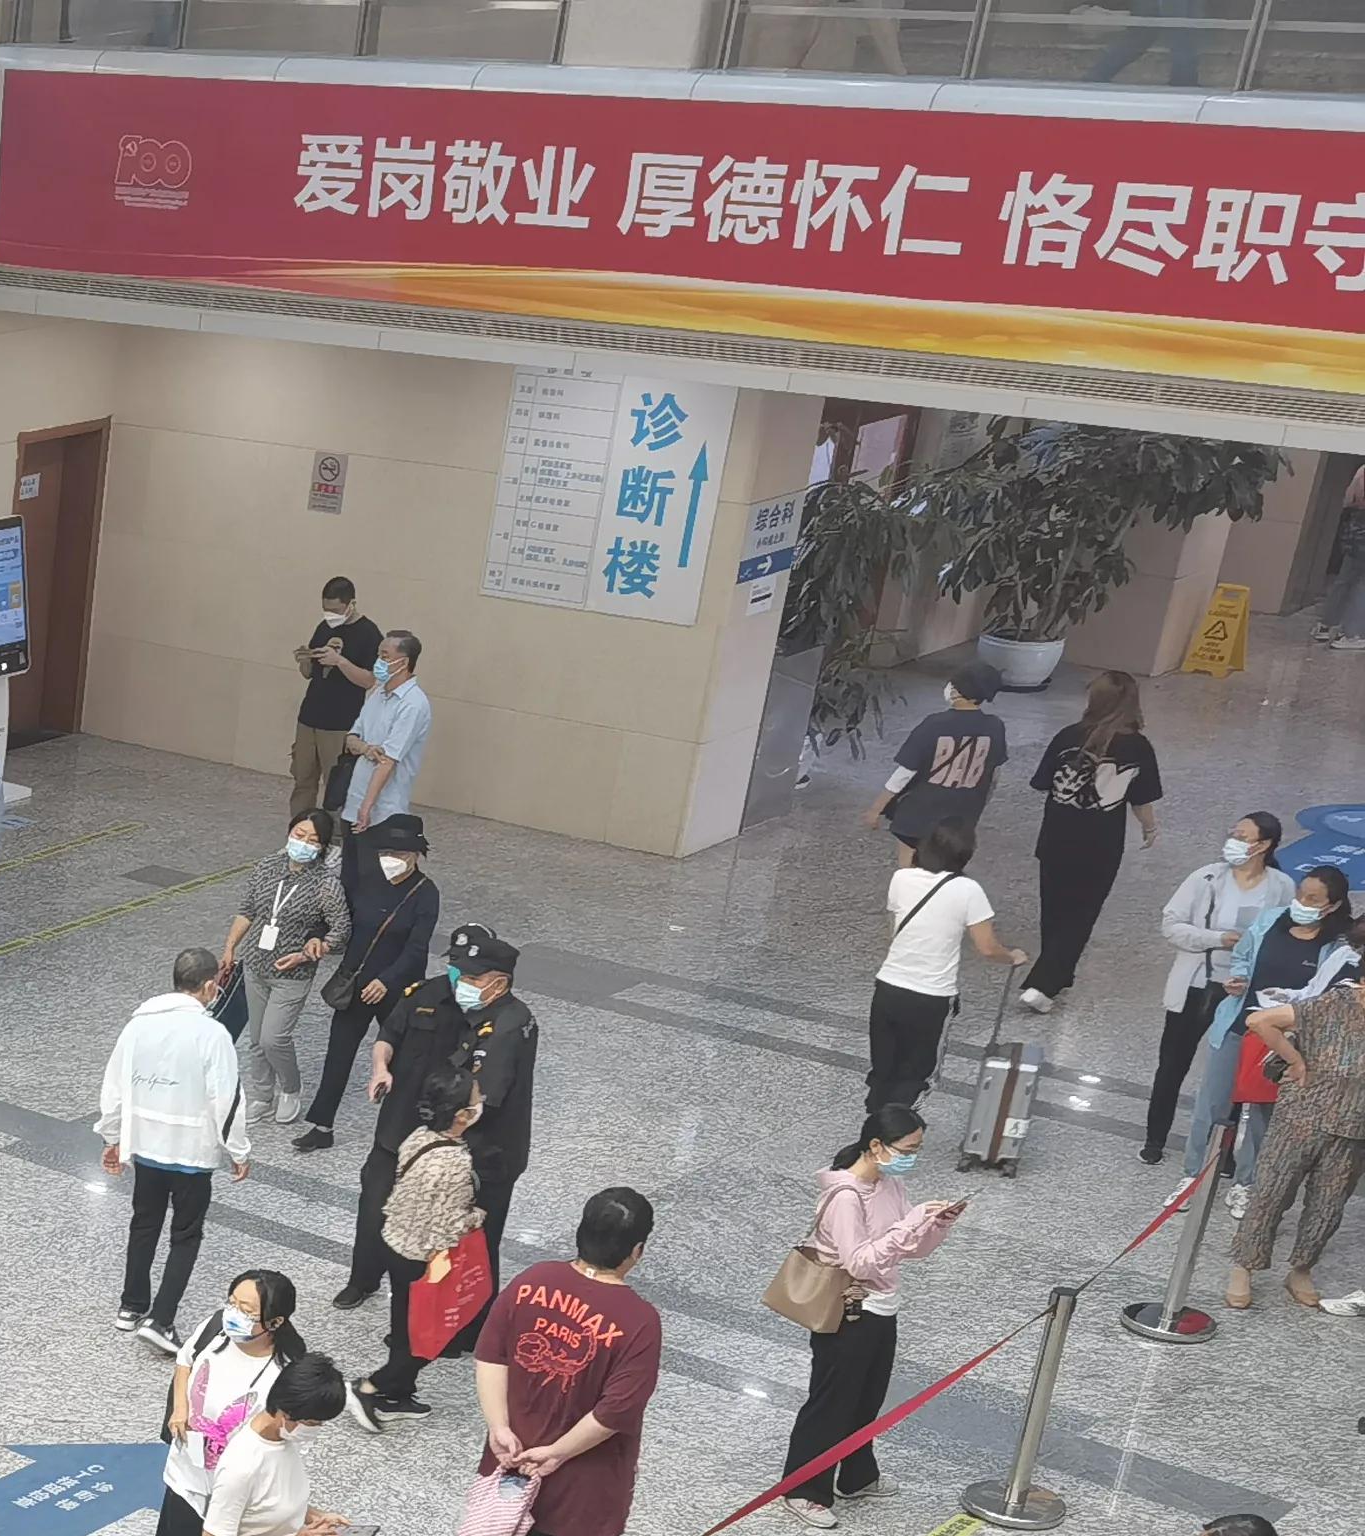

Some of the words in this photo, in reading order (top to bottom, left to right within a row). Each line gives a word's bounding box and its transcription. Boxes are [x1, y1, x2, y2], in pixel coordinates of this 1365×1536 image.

[292, 133, 596, 230] 爱岗敬业
[616, 151, 970, 256] 厚德怀仁
[603, 393, 688, 599] 诊断楼
[516, 1284, 623, 1347] PANMAX
[534, 1318, 582, 1349] PARIS
